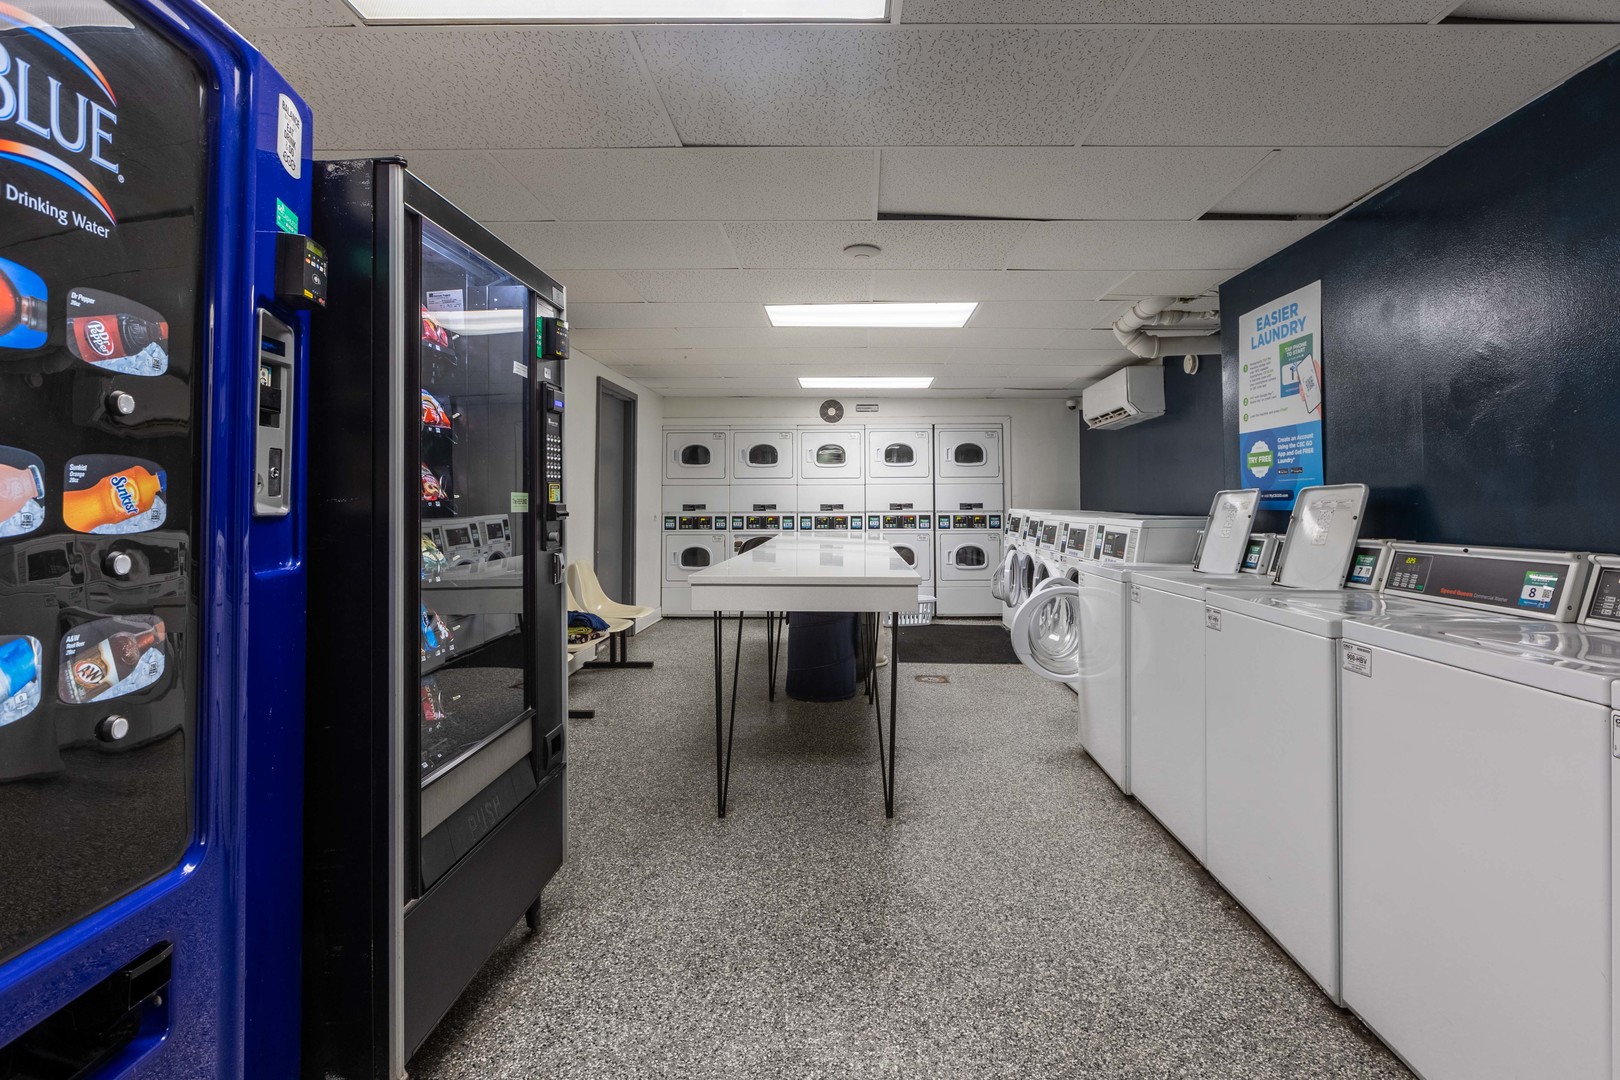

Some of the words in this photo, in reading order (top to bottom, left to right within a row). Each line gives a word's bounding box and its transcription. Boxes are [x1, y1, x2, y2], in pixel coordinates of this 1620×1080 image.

[6, 183, 68, 226] Drinking
[72, 211, 110, 238] Water
[78, 294, 95, 305] Pepper
[1256, 303, 1299, 332] EASIER
[1251, 316, 1306, 350] LAUNDRY
[1258, 455, 1272, 463] FREE
[110, 476, 139, 515] Sunkist
[1357, 567, 1363, 575] 7
[1528, 587, 1537, 598] 8
[65, 634, 81, 643] A&W
[467, 795, 504, 841] PUSH
